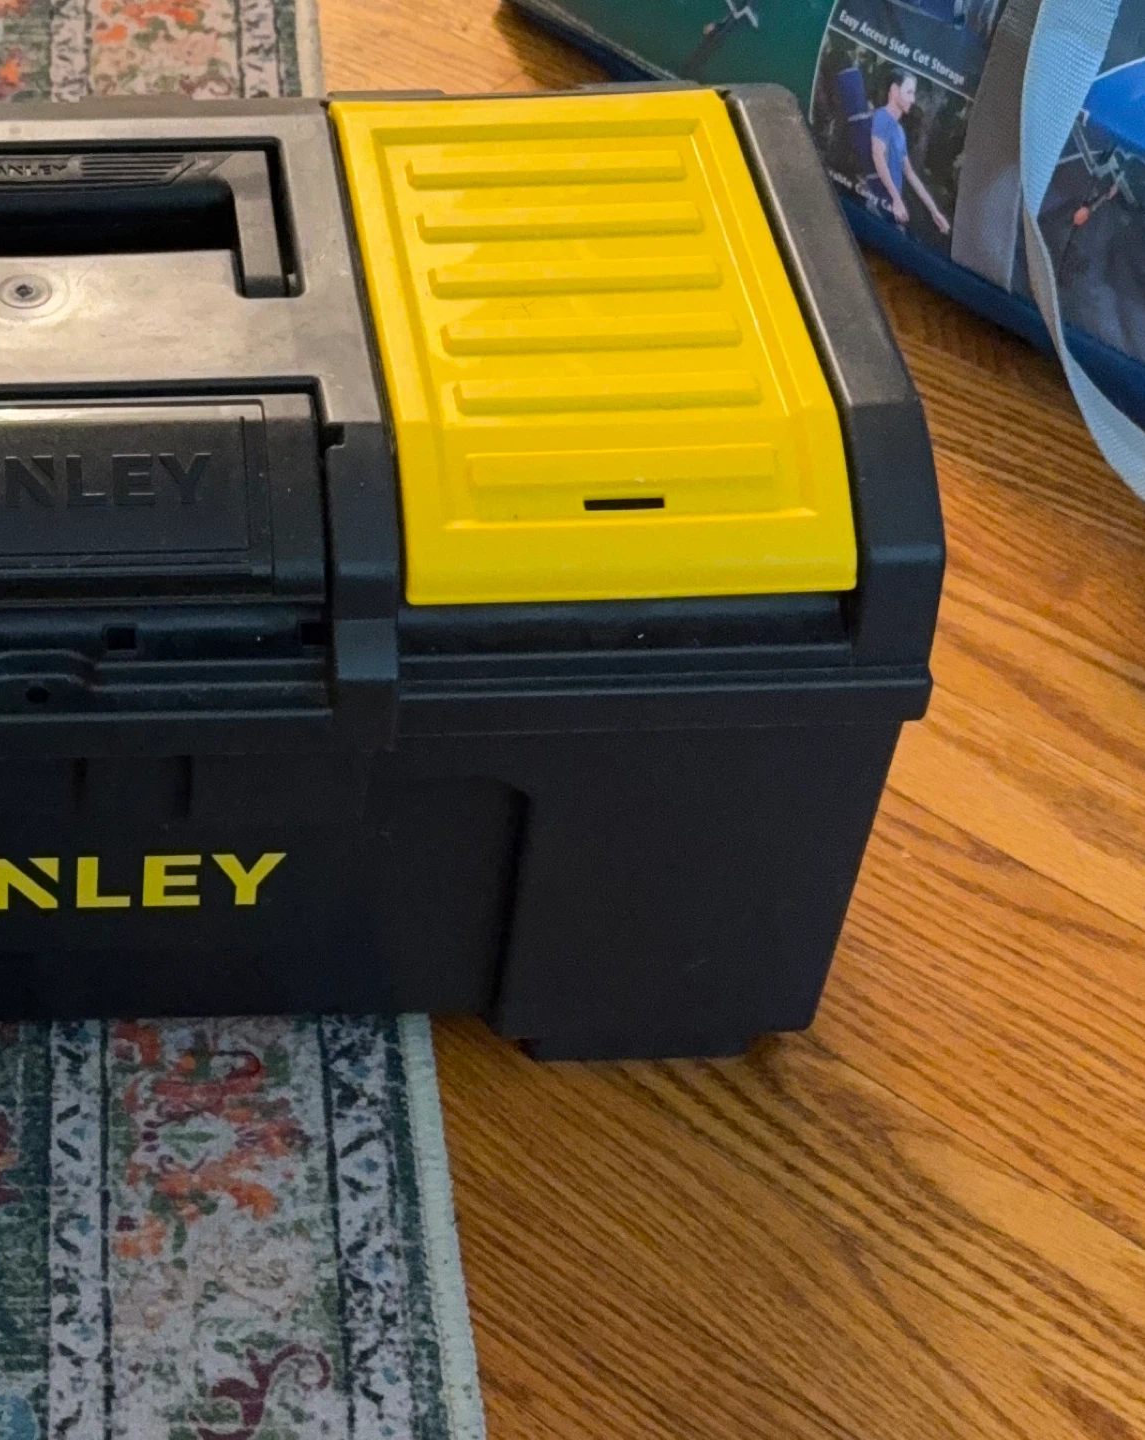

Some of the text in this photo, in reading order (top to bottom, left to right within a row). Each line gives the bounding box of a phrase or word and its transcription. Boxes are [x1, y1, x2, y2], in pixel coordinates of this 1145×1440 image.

[839, 9, 966, 86] Easy Access Side Cot Storage
